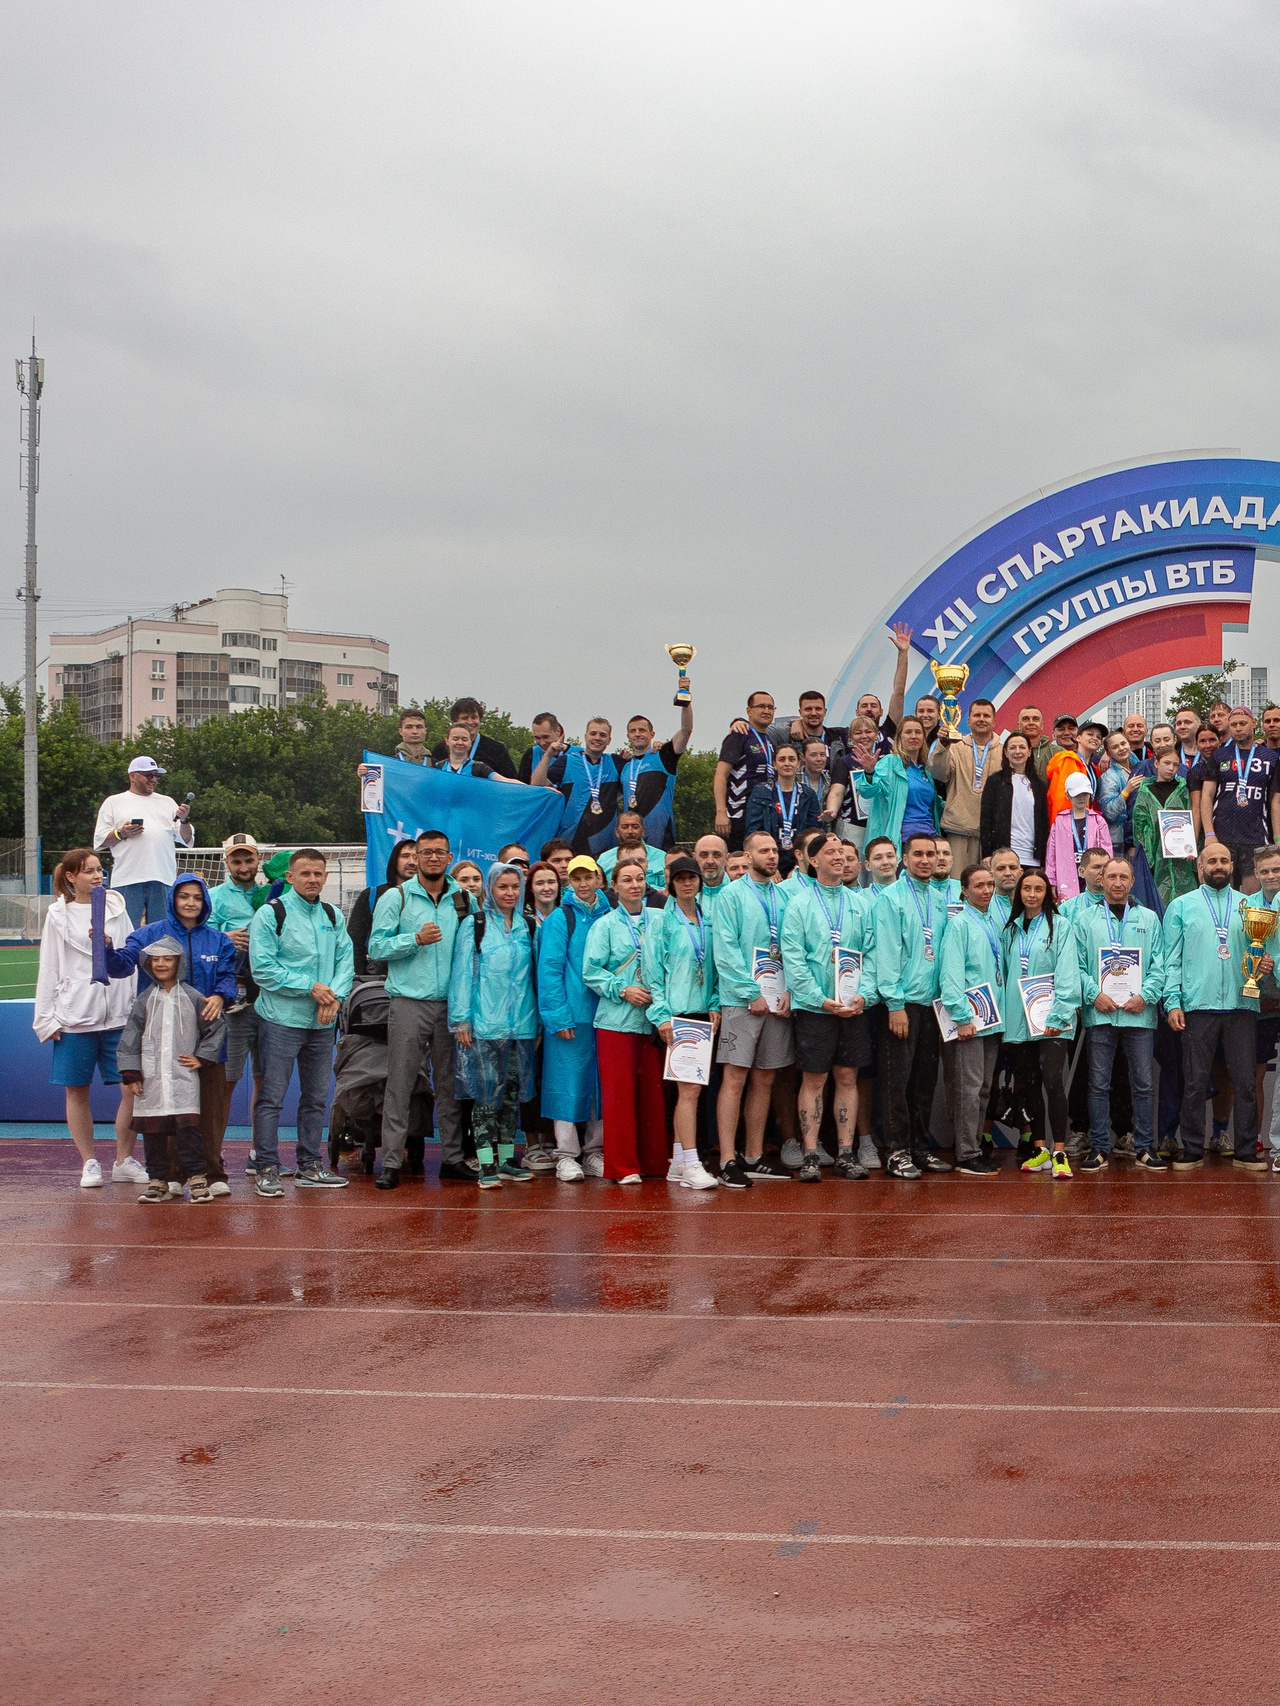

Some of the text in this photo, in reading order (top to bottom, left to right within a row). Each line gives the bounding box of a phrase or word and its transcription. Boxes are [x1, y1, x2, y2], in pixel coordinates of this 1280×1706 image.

[1011, 560, 1236, 656] ГРУППЫ ВТБ
[922, 602, 977, 654] XII
[1250, 757, 1271, 775] 31
[467, 847, 499, 862] ИТ-хо
